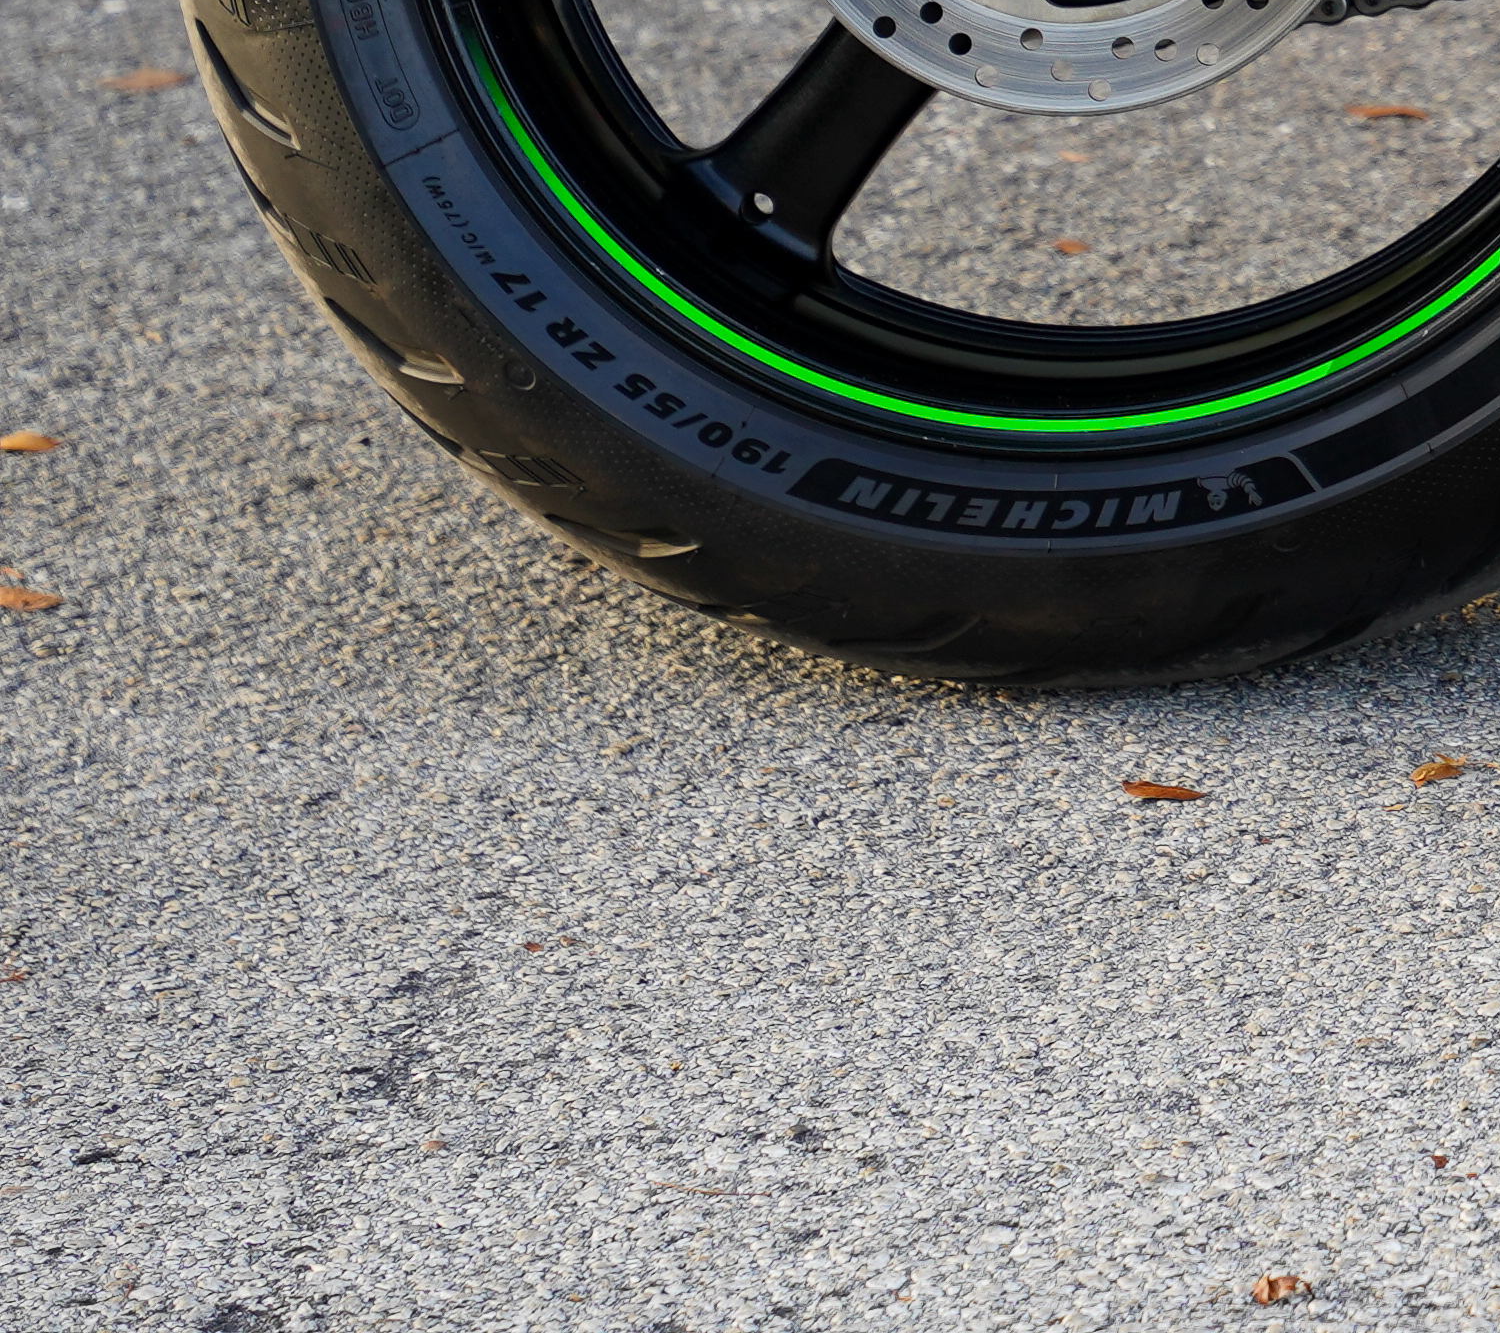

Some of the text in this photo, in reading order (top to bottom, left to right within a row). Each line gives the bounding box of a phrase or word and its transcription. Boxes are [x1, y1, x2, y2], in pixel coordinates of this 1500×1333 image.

[374, 75, 414, 124] DOT
[489, 270, 548, 313] 17
[544, 315, 617, 372] ZR
[612, 372, 793, 475] 190/55
[838, 475, 1183, 531] MICHELIN
